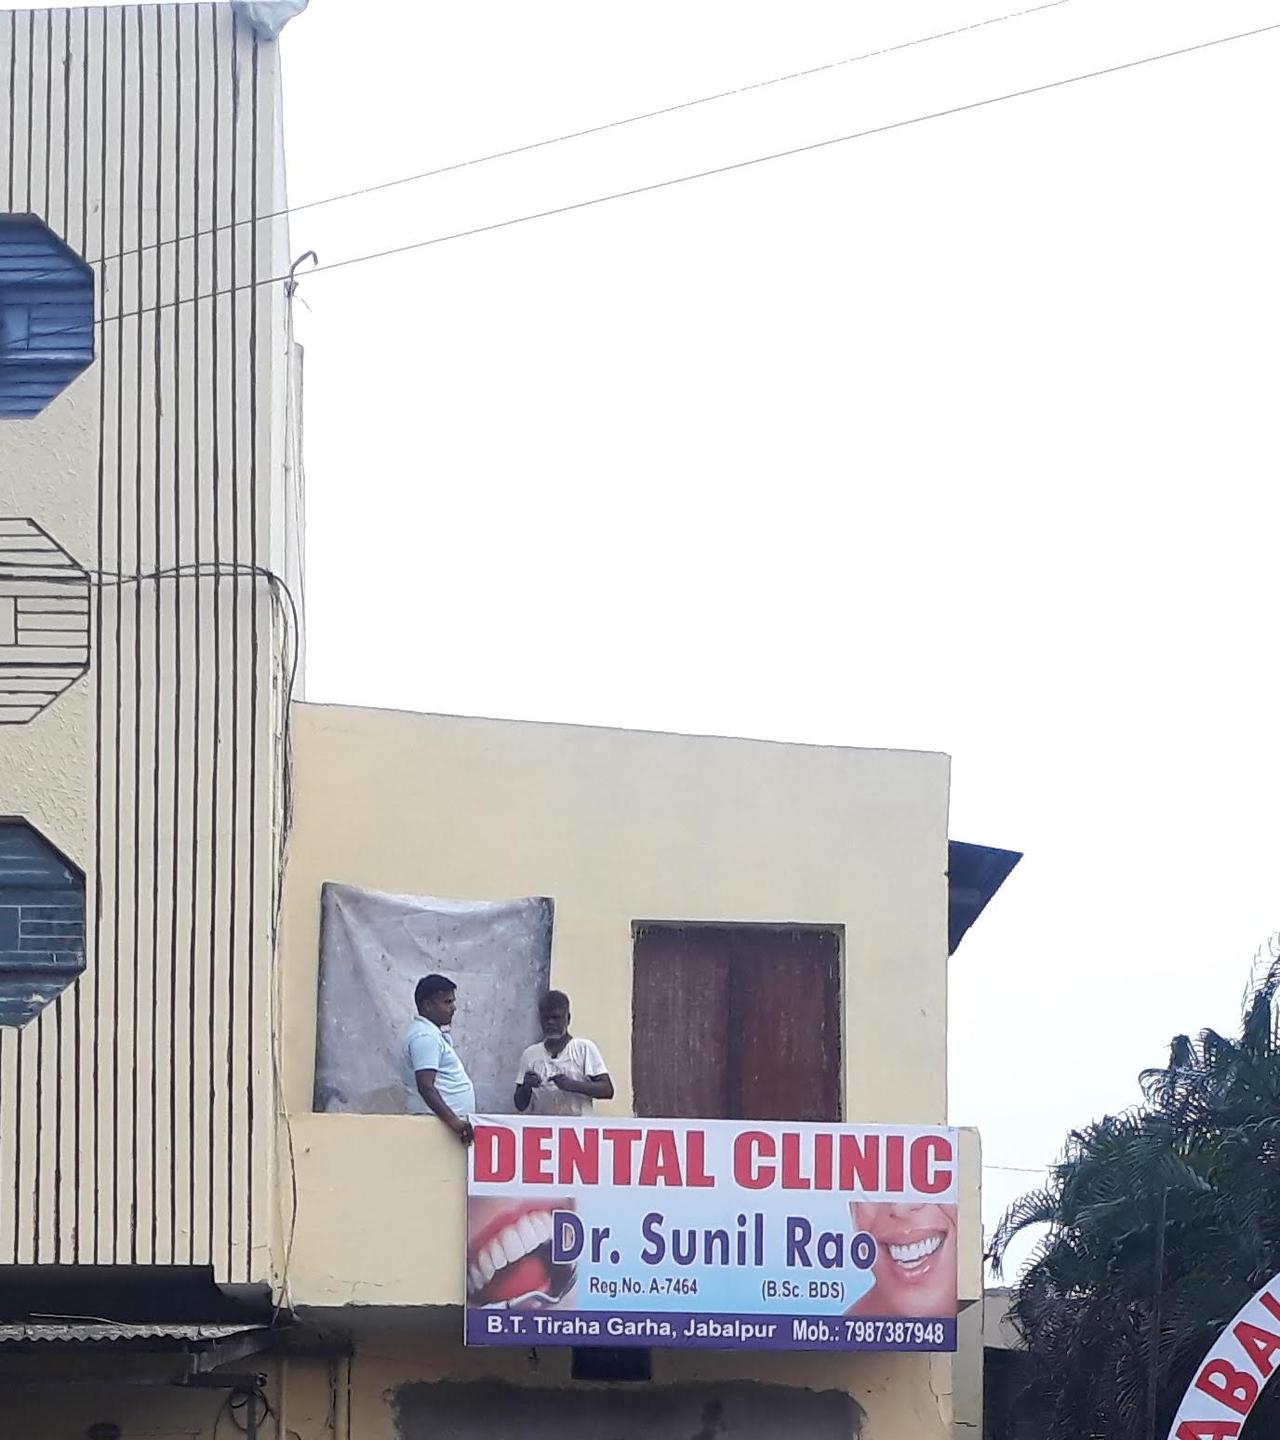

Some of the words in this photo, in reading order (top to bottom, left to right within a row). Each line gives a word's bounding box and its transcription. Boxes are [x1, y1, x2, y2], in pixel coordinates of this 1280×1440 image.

[473, 1125, 715, 1188] DENTAL
[733, 1130, 953, 1194] CLINIC
[552, 1210, 619, 1265] Dr.
[641, 1212, 764, 1269] Sunil
[786, 1216, 878, 1272] Rao
[649, 1278, 698, 1295] A-7464
[809, 1281, 845, 1302] BDS)
[487, 1315, 527, 1335] B.T.
[534, 1316, 600, 1336] Tiraha
[607, 1319, 677, 1338] Garha,
[684, 1320, 777, 1341] Jabalpur
[845, 1322, 944, 1344] 7987387948
